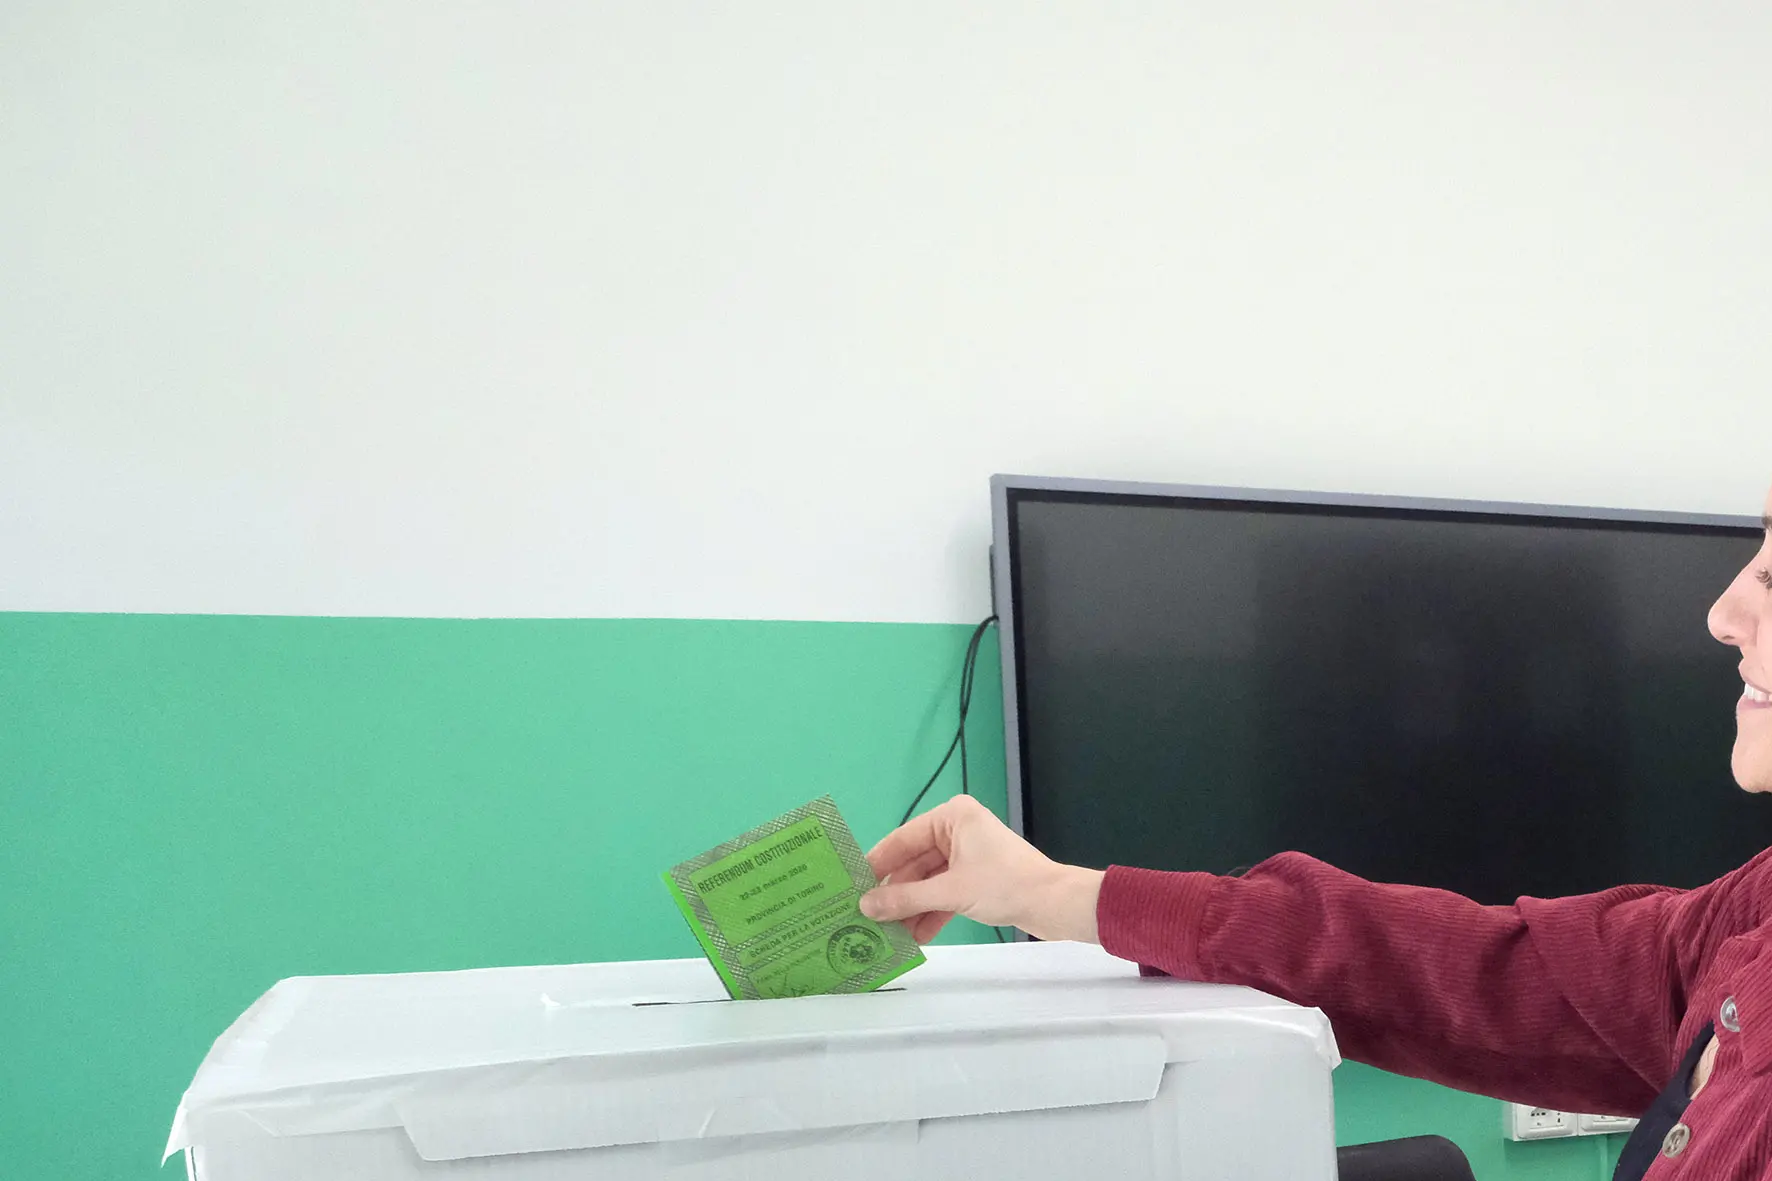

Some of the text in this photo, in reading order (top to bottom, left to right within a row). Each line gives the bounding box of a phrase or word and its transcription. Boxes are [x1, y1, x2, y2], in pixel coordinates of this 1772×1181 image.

[698, 826, 823, 894] REFERENDUM COSTITUZIONALE
[746, 901, 787, 925] PROVINCIA
[797, 882, 824, 899] TORINO
[750, 938, 781, 958] SCHEDA
[782, 929, 798, 941] PER
[811, 902, 850, 925] VOTAZIONE
